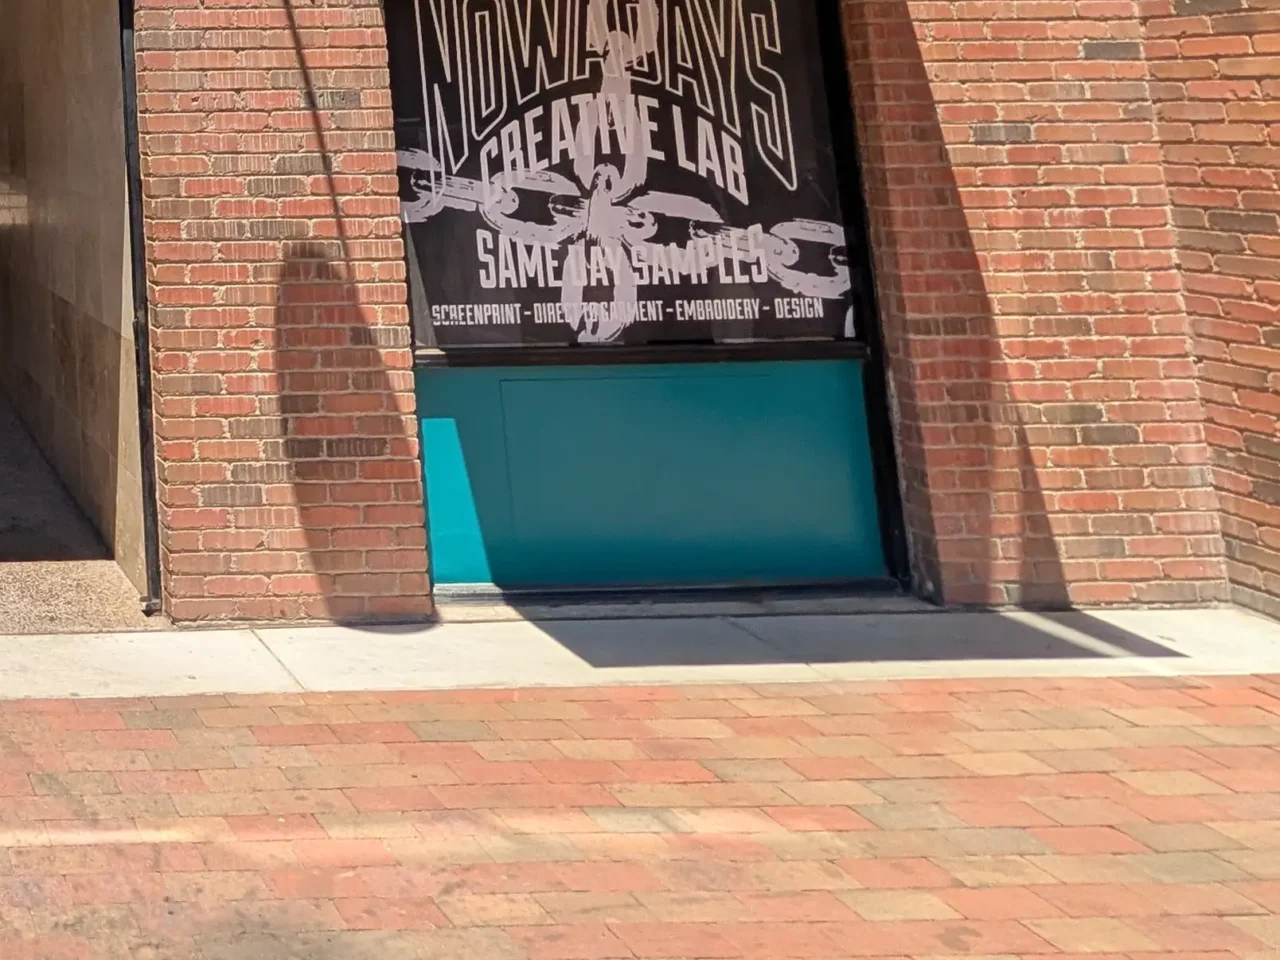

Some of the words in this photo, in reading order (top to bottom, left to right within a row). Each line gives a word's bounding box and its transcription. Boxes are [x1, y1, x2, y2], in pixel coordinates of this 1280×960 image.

[479, 93, 665, 209] CREATIVE
[671, 104, 749, 206] LAB
[475, 228, 562, 289] SAME
[568, 244, 623, 287] DAY
[631, 223, 768, 285] SAMPLES
[431, 303, 522, 326] SCREENPRINT
[675, 298, 761, 321] EMBROIDERY
[774, 297, 824, 319] DESIGN
